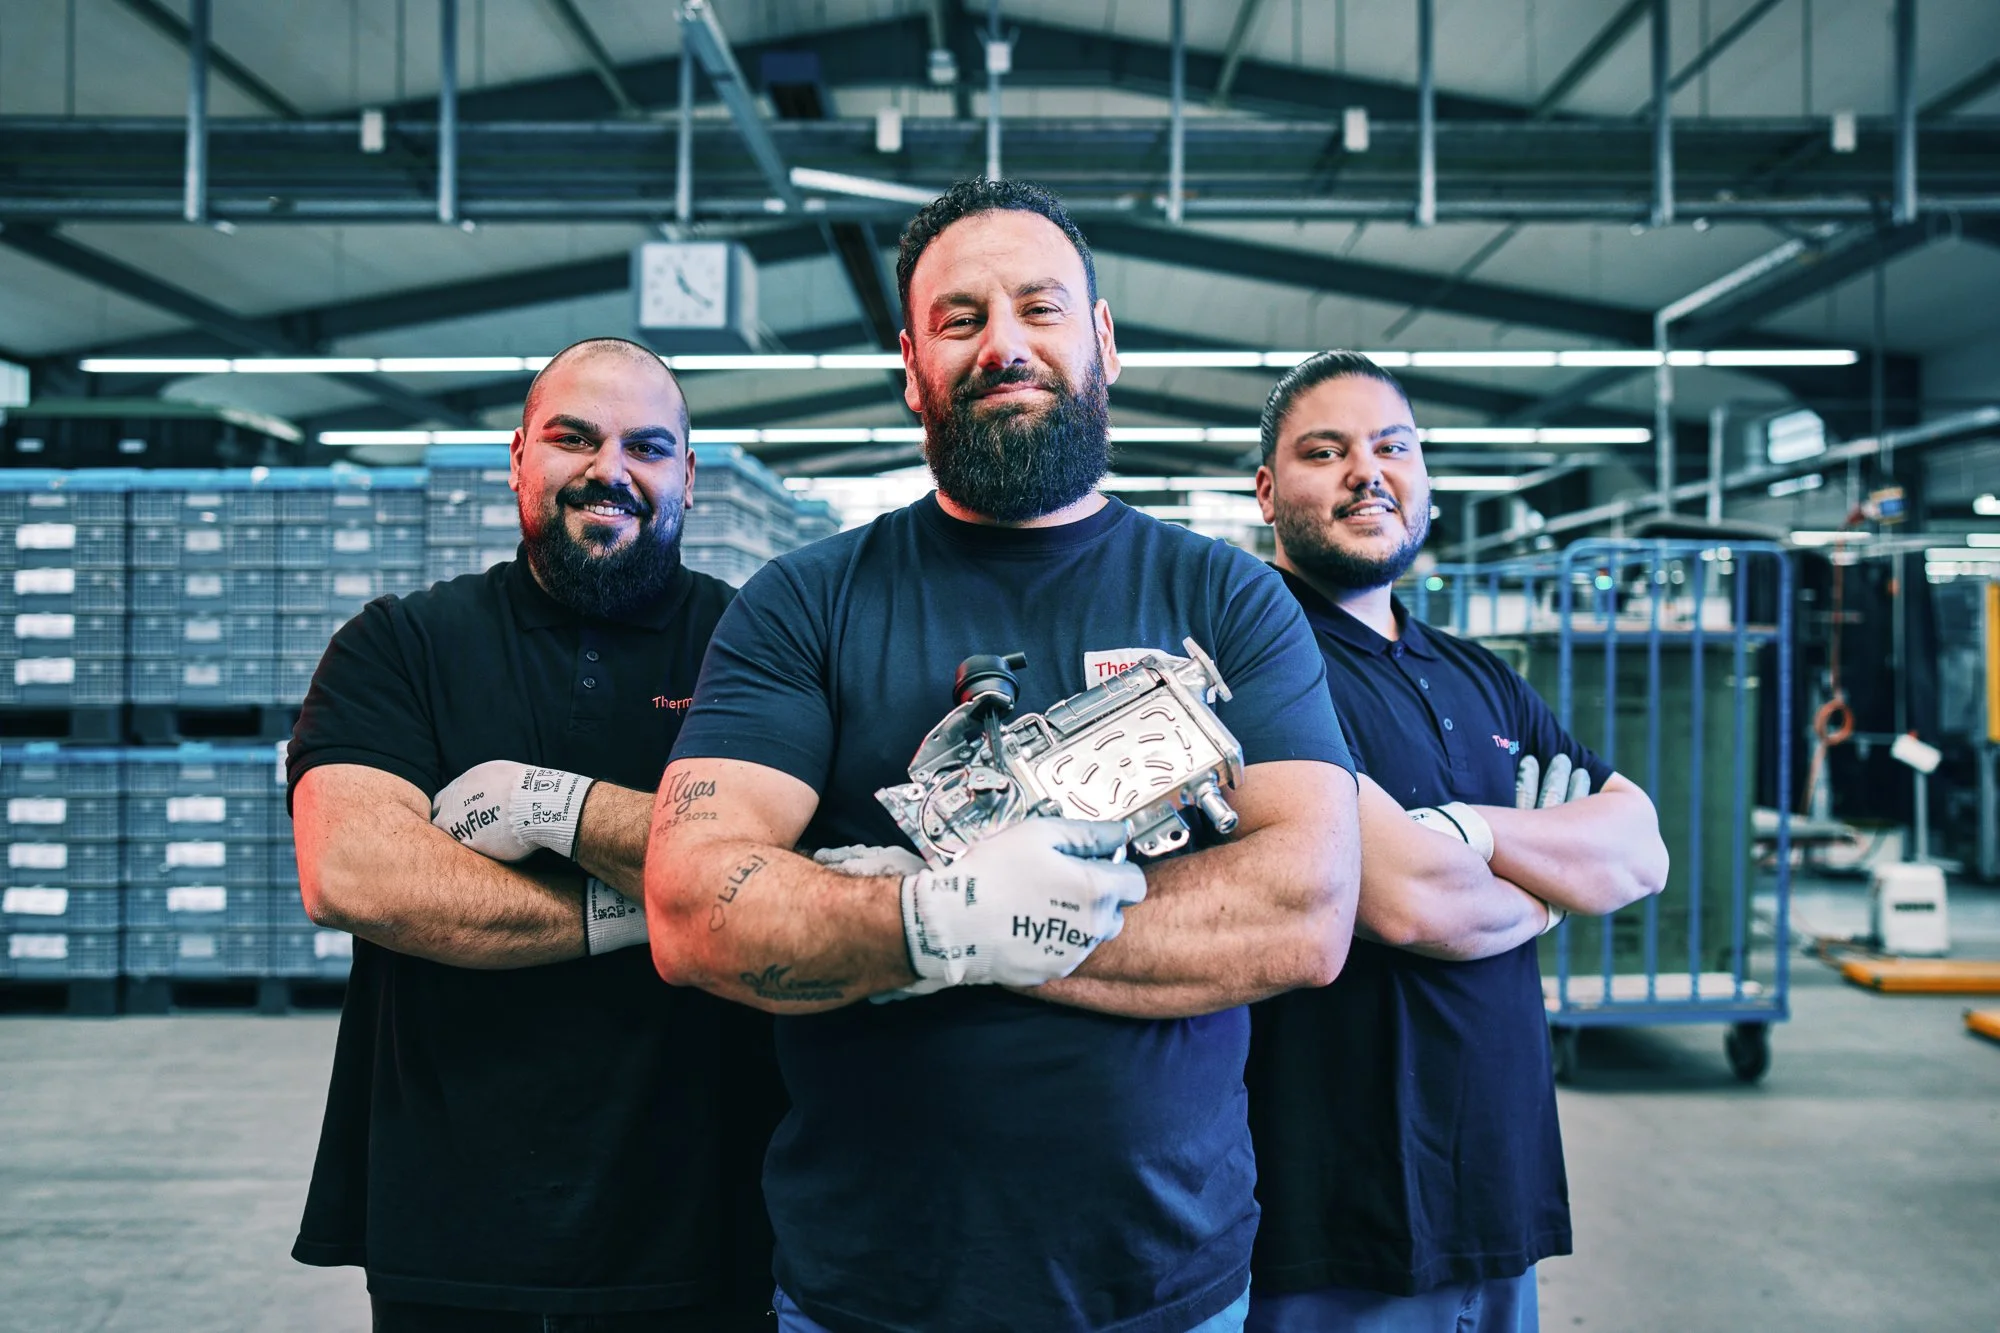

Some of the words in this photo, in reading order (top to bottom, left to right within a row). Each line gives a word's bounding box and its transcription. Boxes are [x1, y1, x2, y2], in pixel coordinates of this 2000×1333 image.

[652, 695, 693, 709] Therm
[464, 792, 484, 807] 11-800
[662, 771, 716, 815] Ilyas
[1012, 915, 1094, 948] HyFlex
